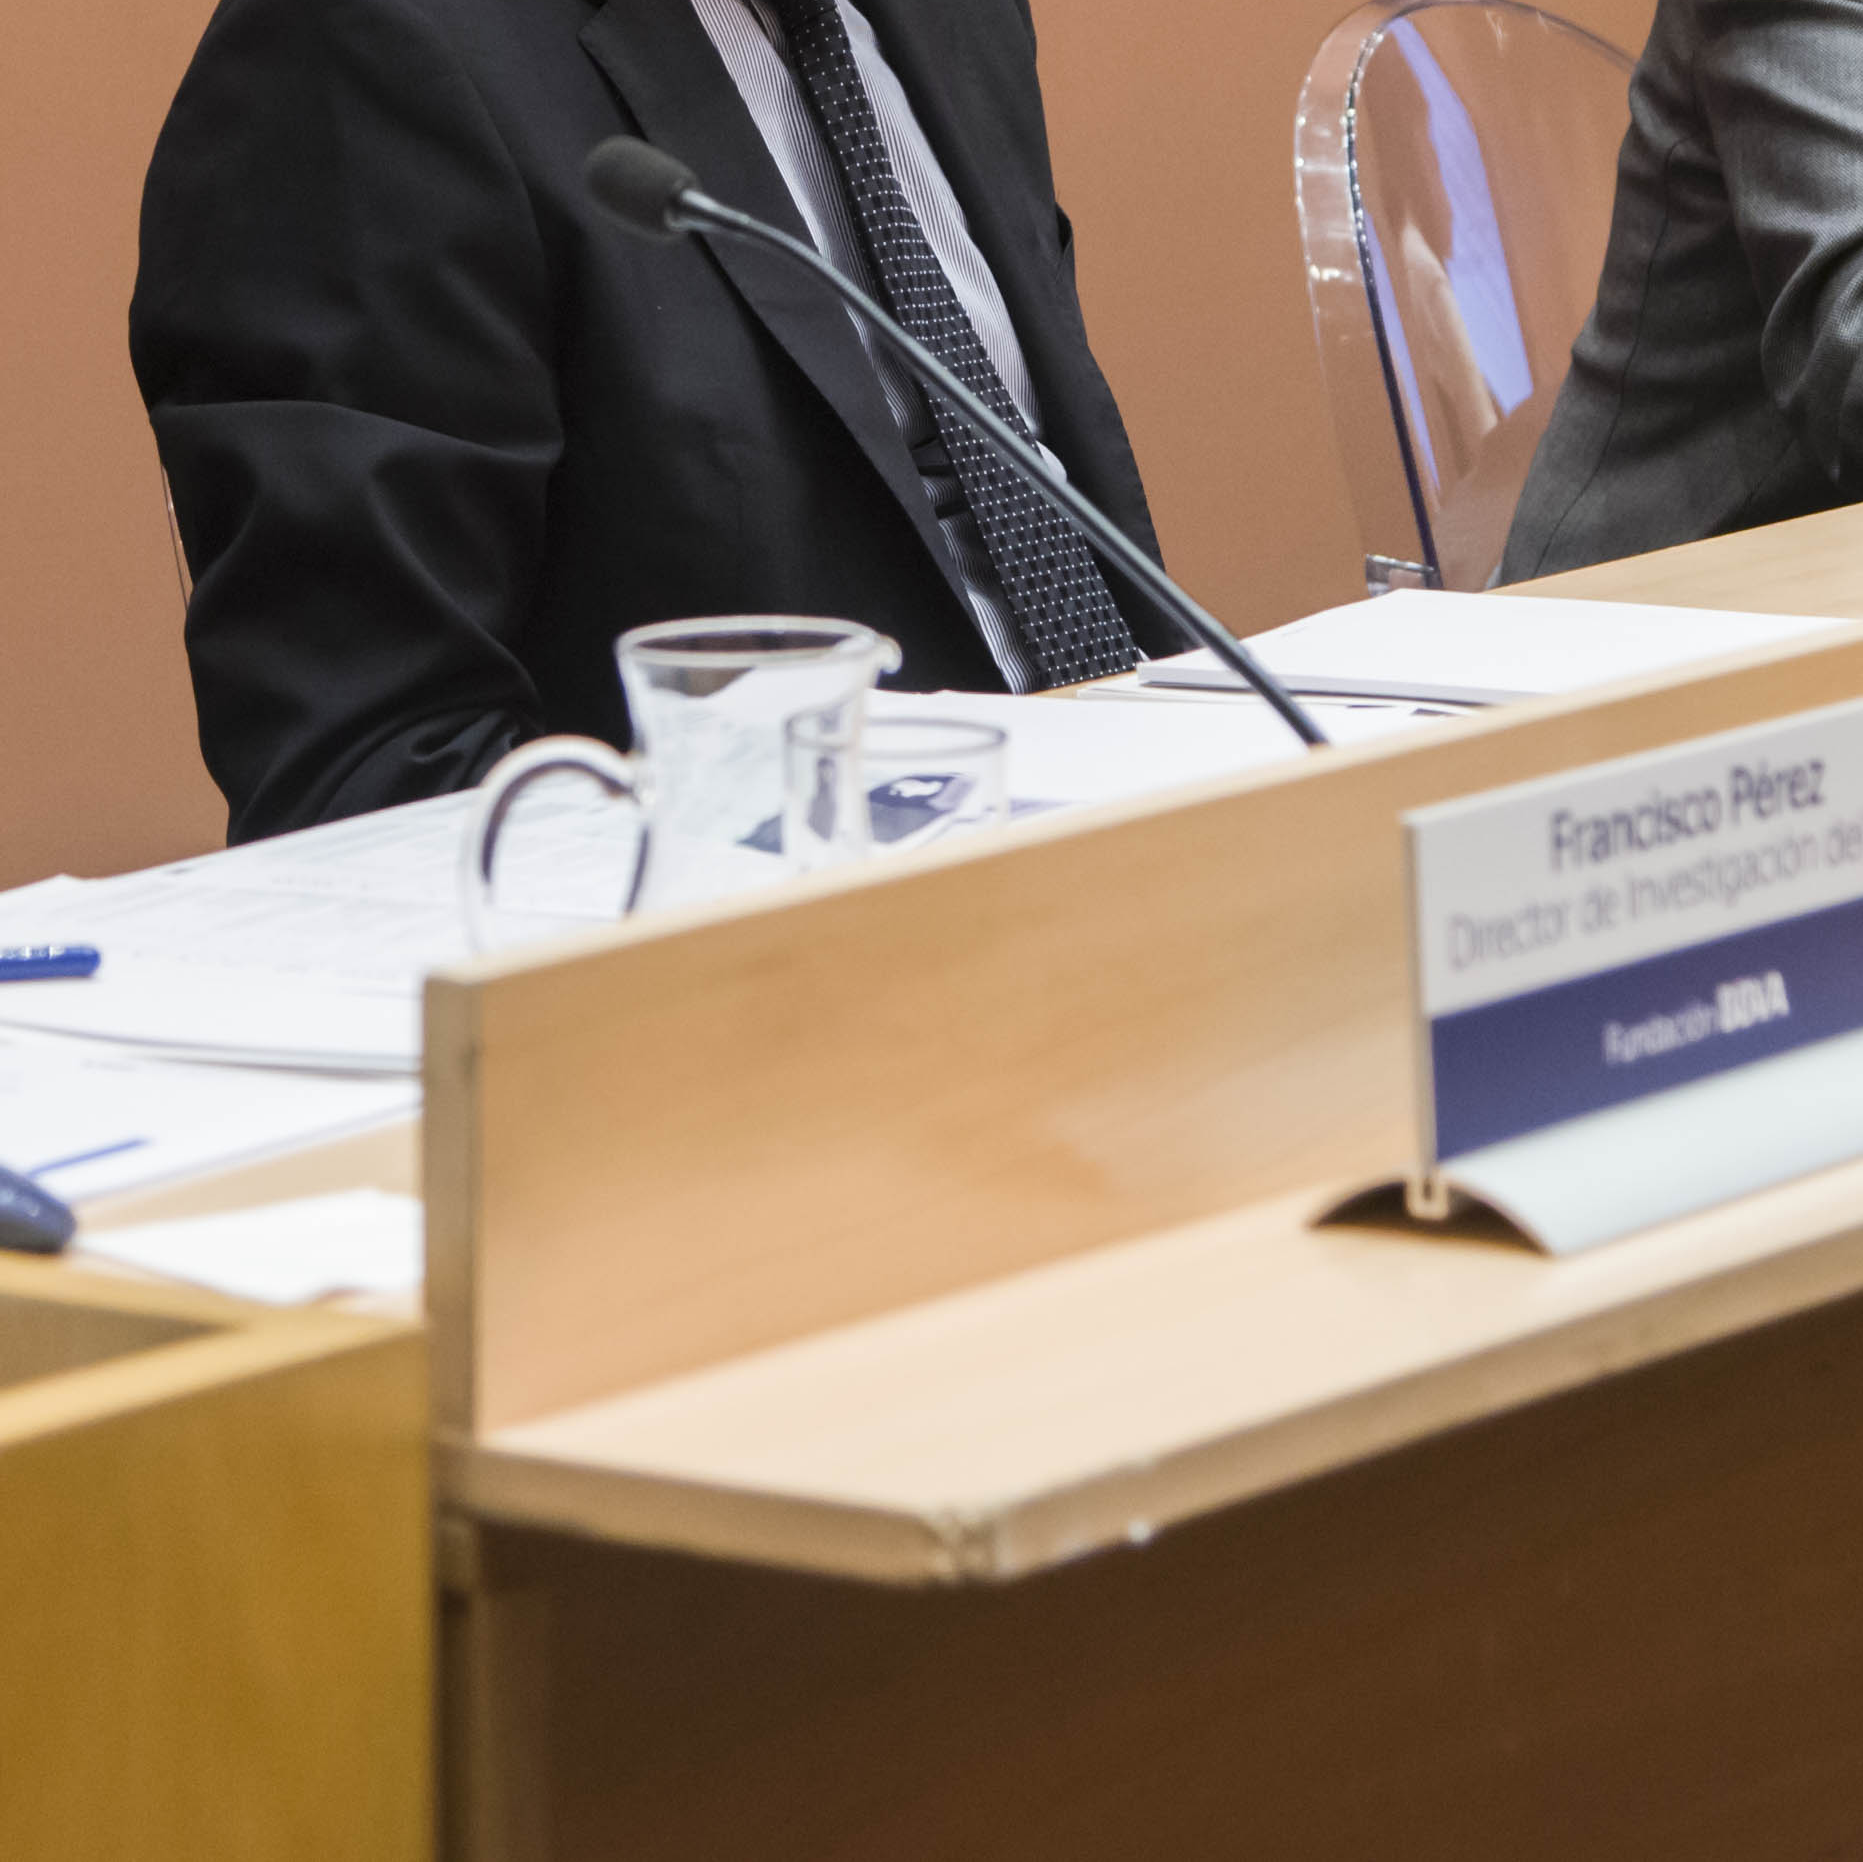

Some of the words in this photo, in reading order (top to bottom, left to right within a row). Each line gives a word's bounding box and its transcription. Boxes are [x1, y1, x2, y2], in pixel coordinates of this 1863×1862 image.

[1549, 783, 1721, 873] Francisco
[1729, 758, 1825, 826] Pérez
[1448, 898, 1569, 972] Director
[1583, 883, 1618, 934] de
[1629, 829, 1817, 920] Investigación
[1825, 818, 1862, 866] del
[1715, 969, 1790, 1033] BBVA
